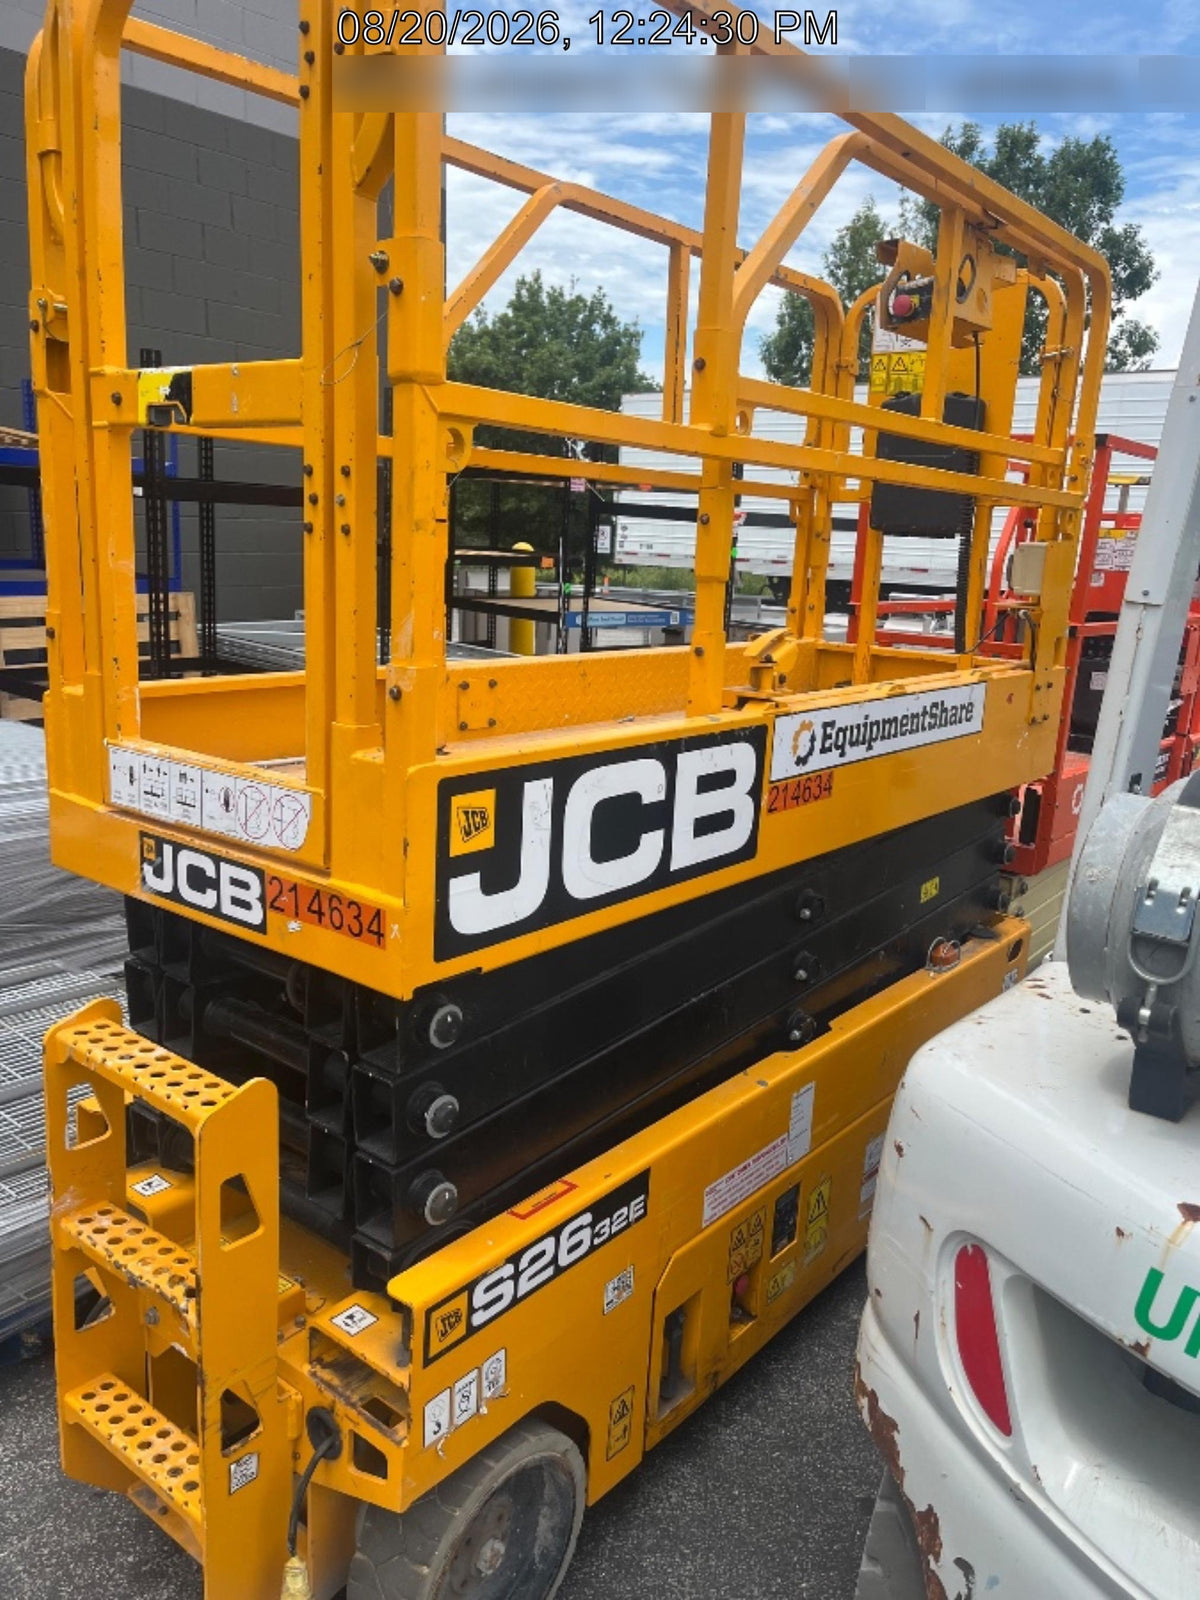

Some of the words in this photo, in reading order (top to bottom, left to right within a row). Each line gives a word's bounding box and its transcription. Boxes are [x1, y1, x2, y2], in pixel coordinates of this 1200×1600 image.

[819, 699, 975, 758] EquipmentShare
[461, 809, 489, 839] JCB
[767, 771, 833, 813] 214634
[448, 741, 757, 936] JCB
[142, 843, 264, 926] JCB
[268, 875, 385, 947] 214634
